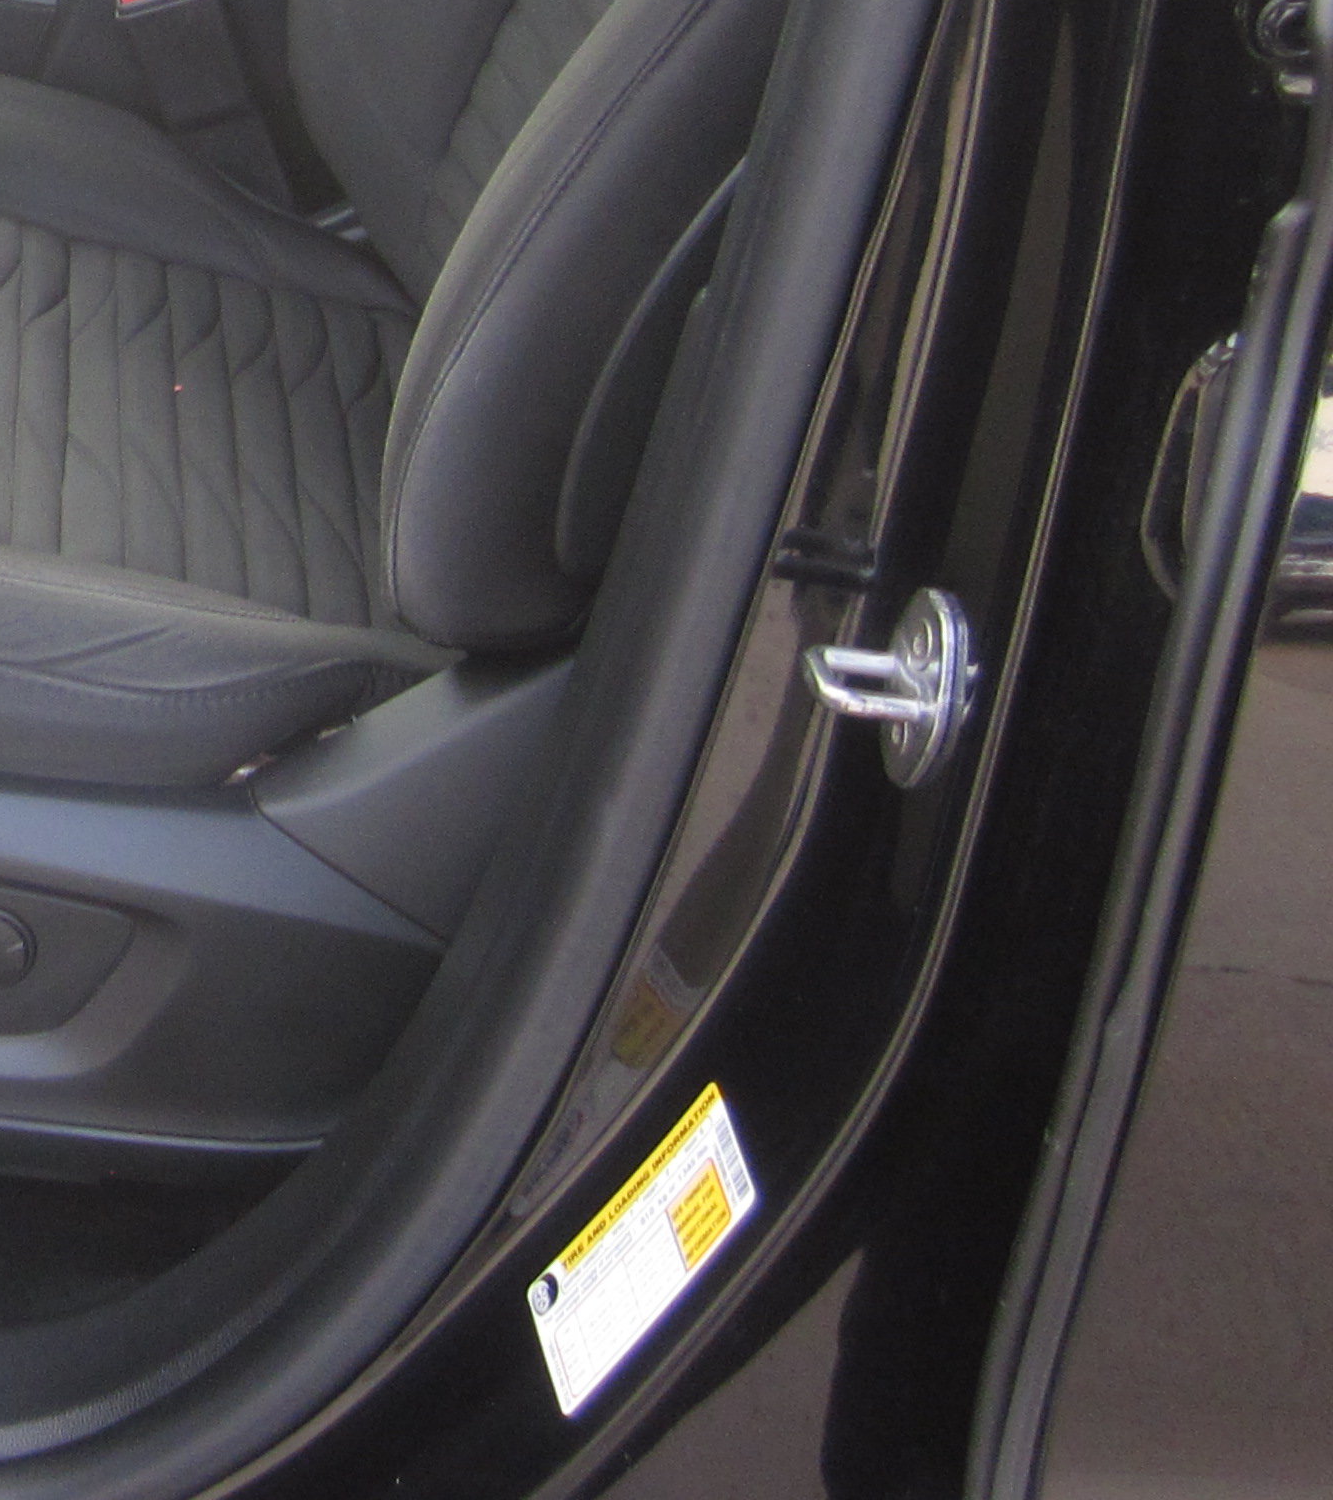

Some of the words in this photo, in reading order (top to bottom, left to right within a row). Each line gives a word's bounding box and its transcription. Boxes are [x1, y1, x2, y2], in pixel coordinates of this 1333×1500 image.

[561, 1243, 584, 1270] TIRE
[587, 1219, 606, 1245] AND
[608, 1170, 650, 1221] LOADING
[652, 1091, 716, 1171] INFORMATION
